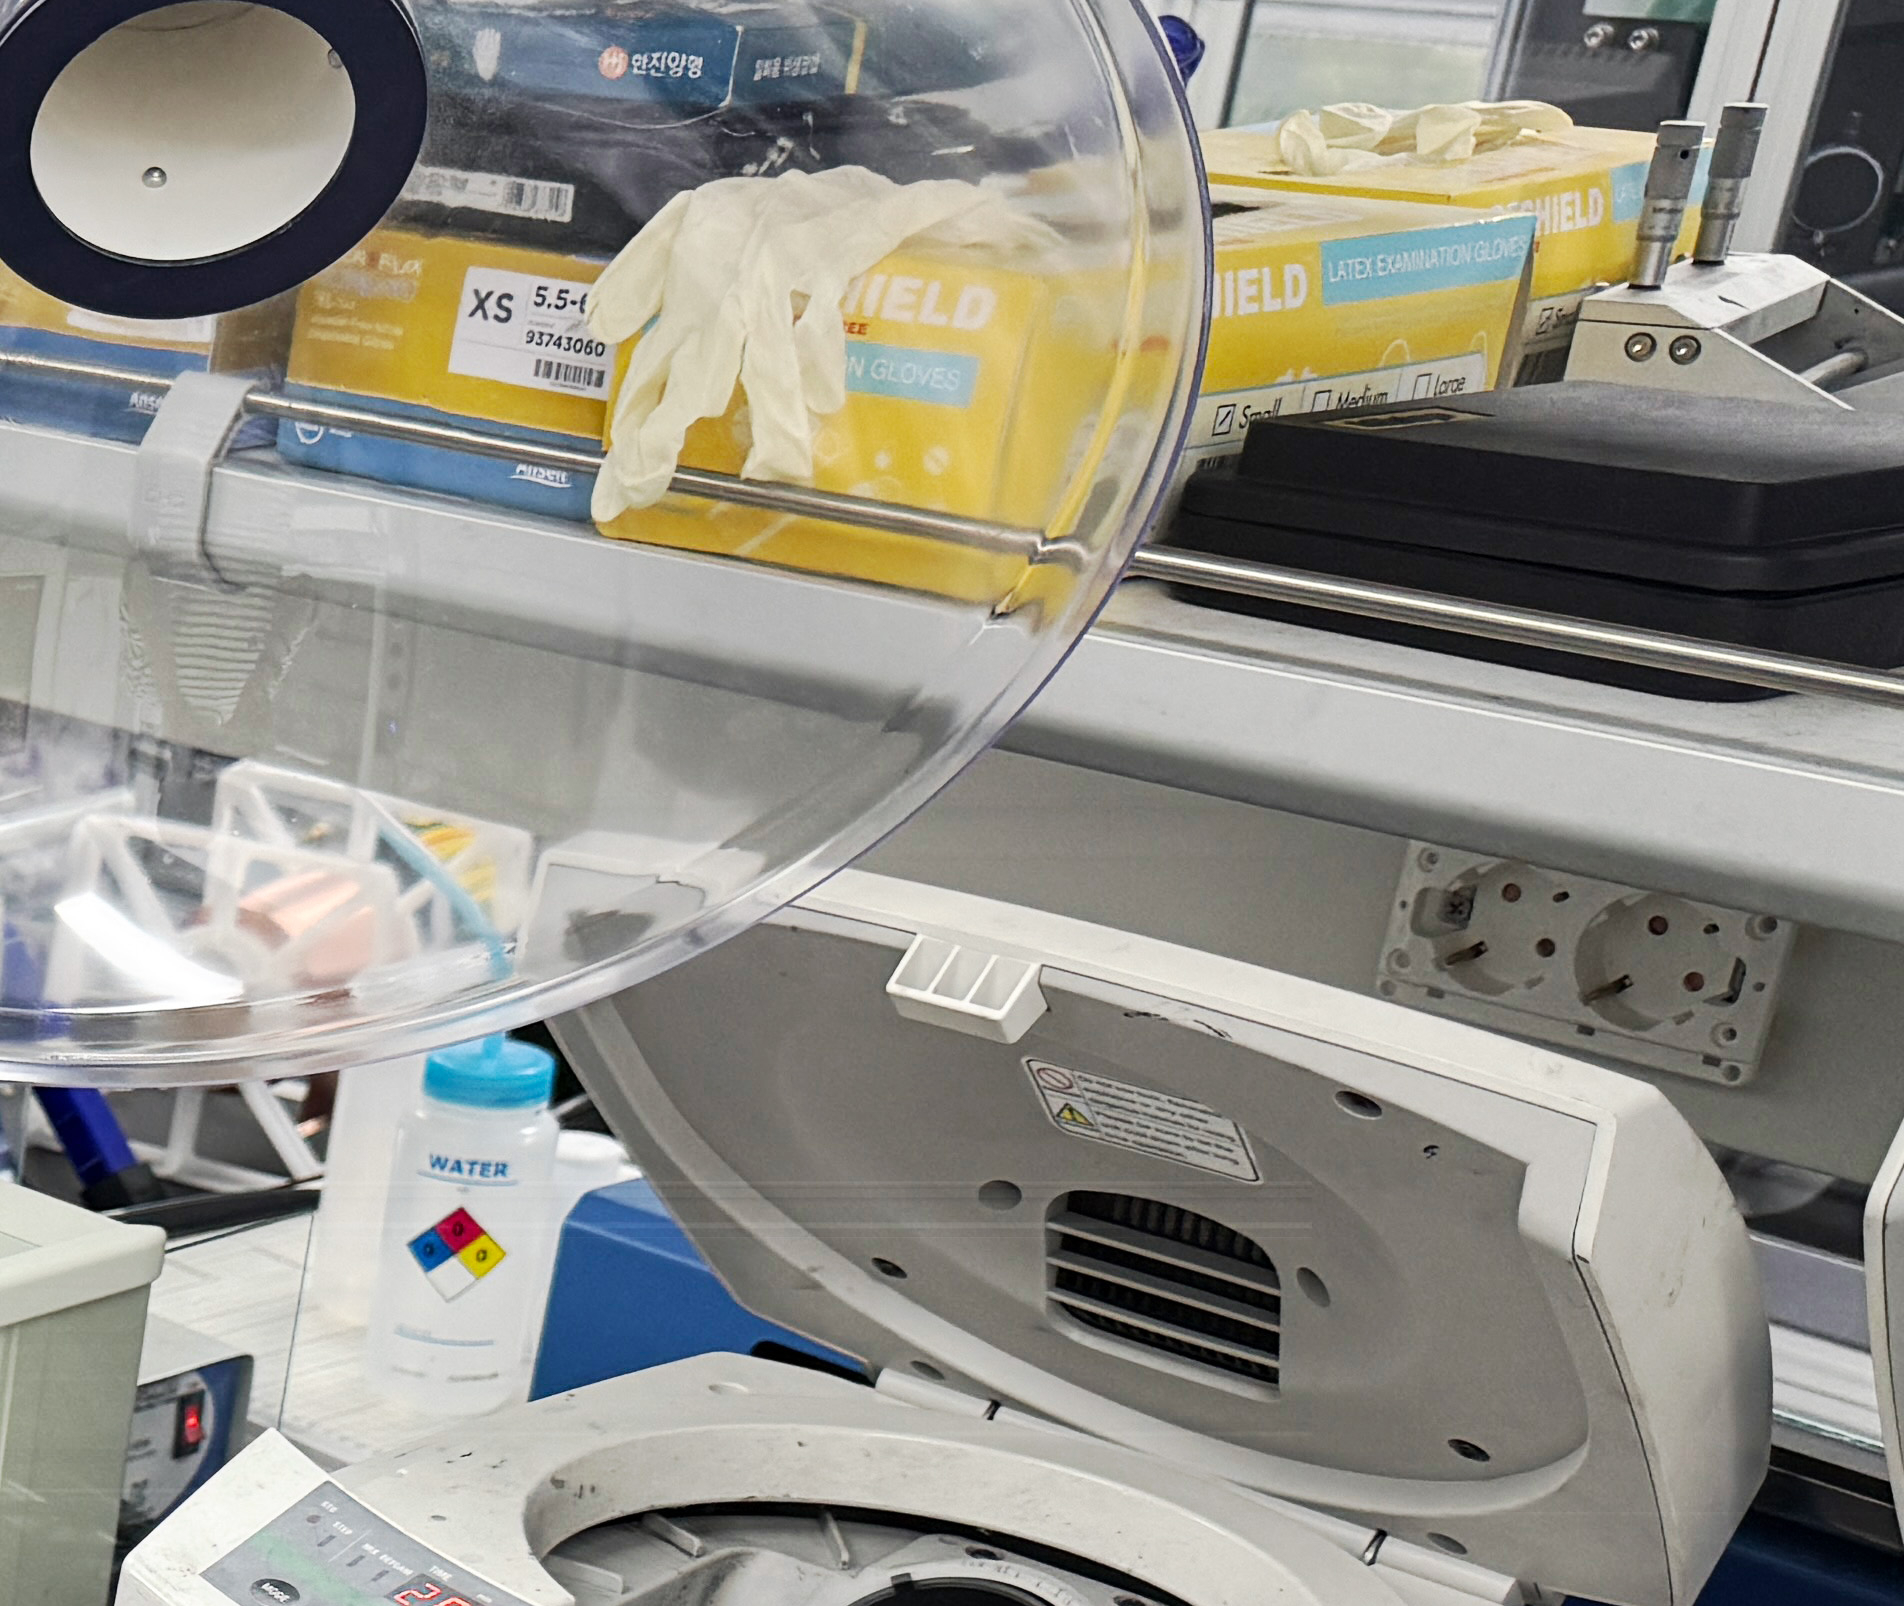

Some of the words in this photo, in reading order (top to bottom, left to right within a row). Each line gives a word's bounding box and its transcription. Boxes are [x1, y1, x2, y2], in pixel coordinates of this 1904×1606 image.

[1328, 255, 1373, 283] LATEX
[1378, 245, 1470, 276] EXAMINATION
[1475, 234, 1528, 263] GLOVES
[468, 288, 514, 324] XS
[525, 330, 606, 358] 93743060
[870, 360, 961, 391] GLOVES
[1239, 397, 1283, 429] Small
[429, 1153, 509, 1178] WATER
